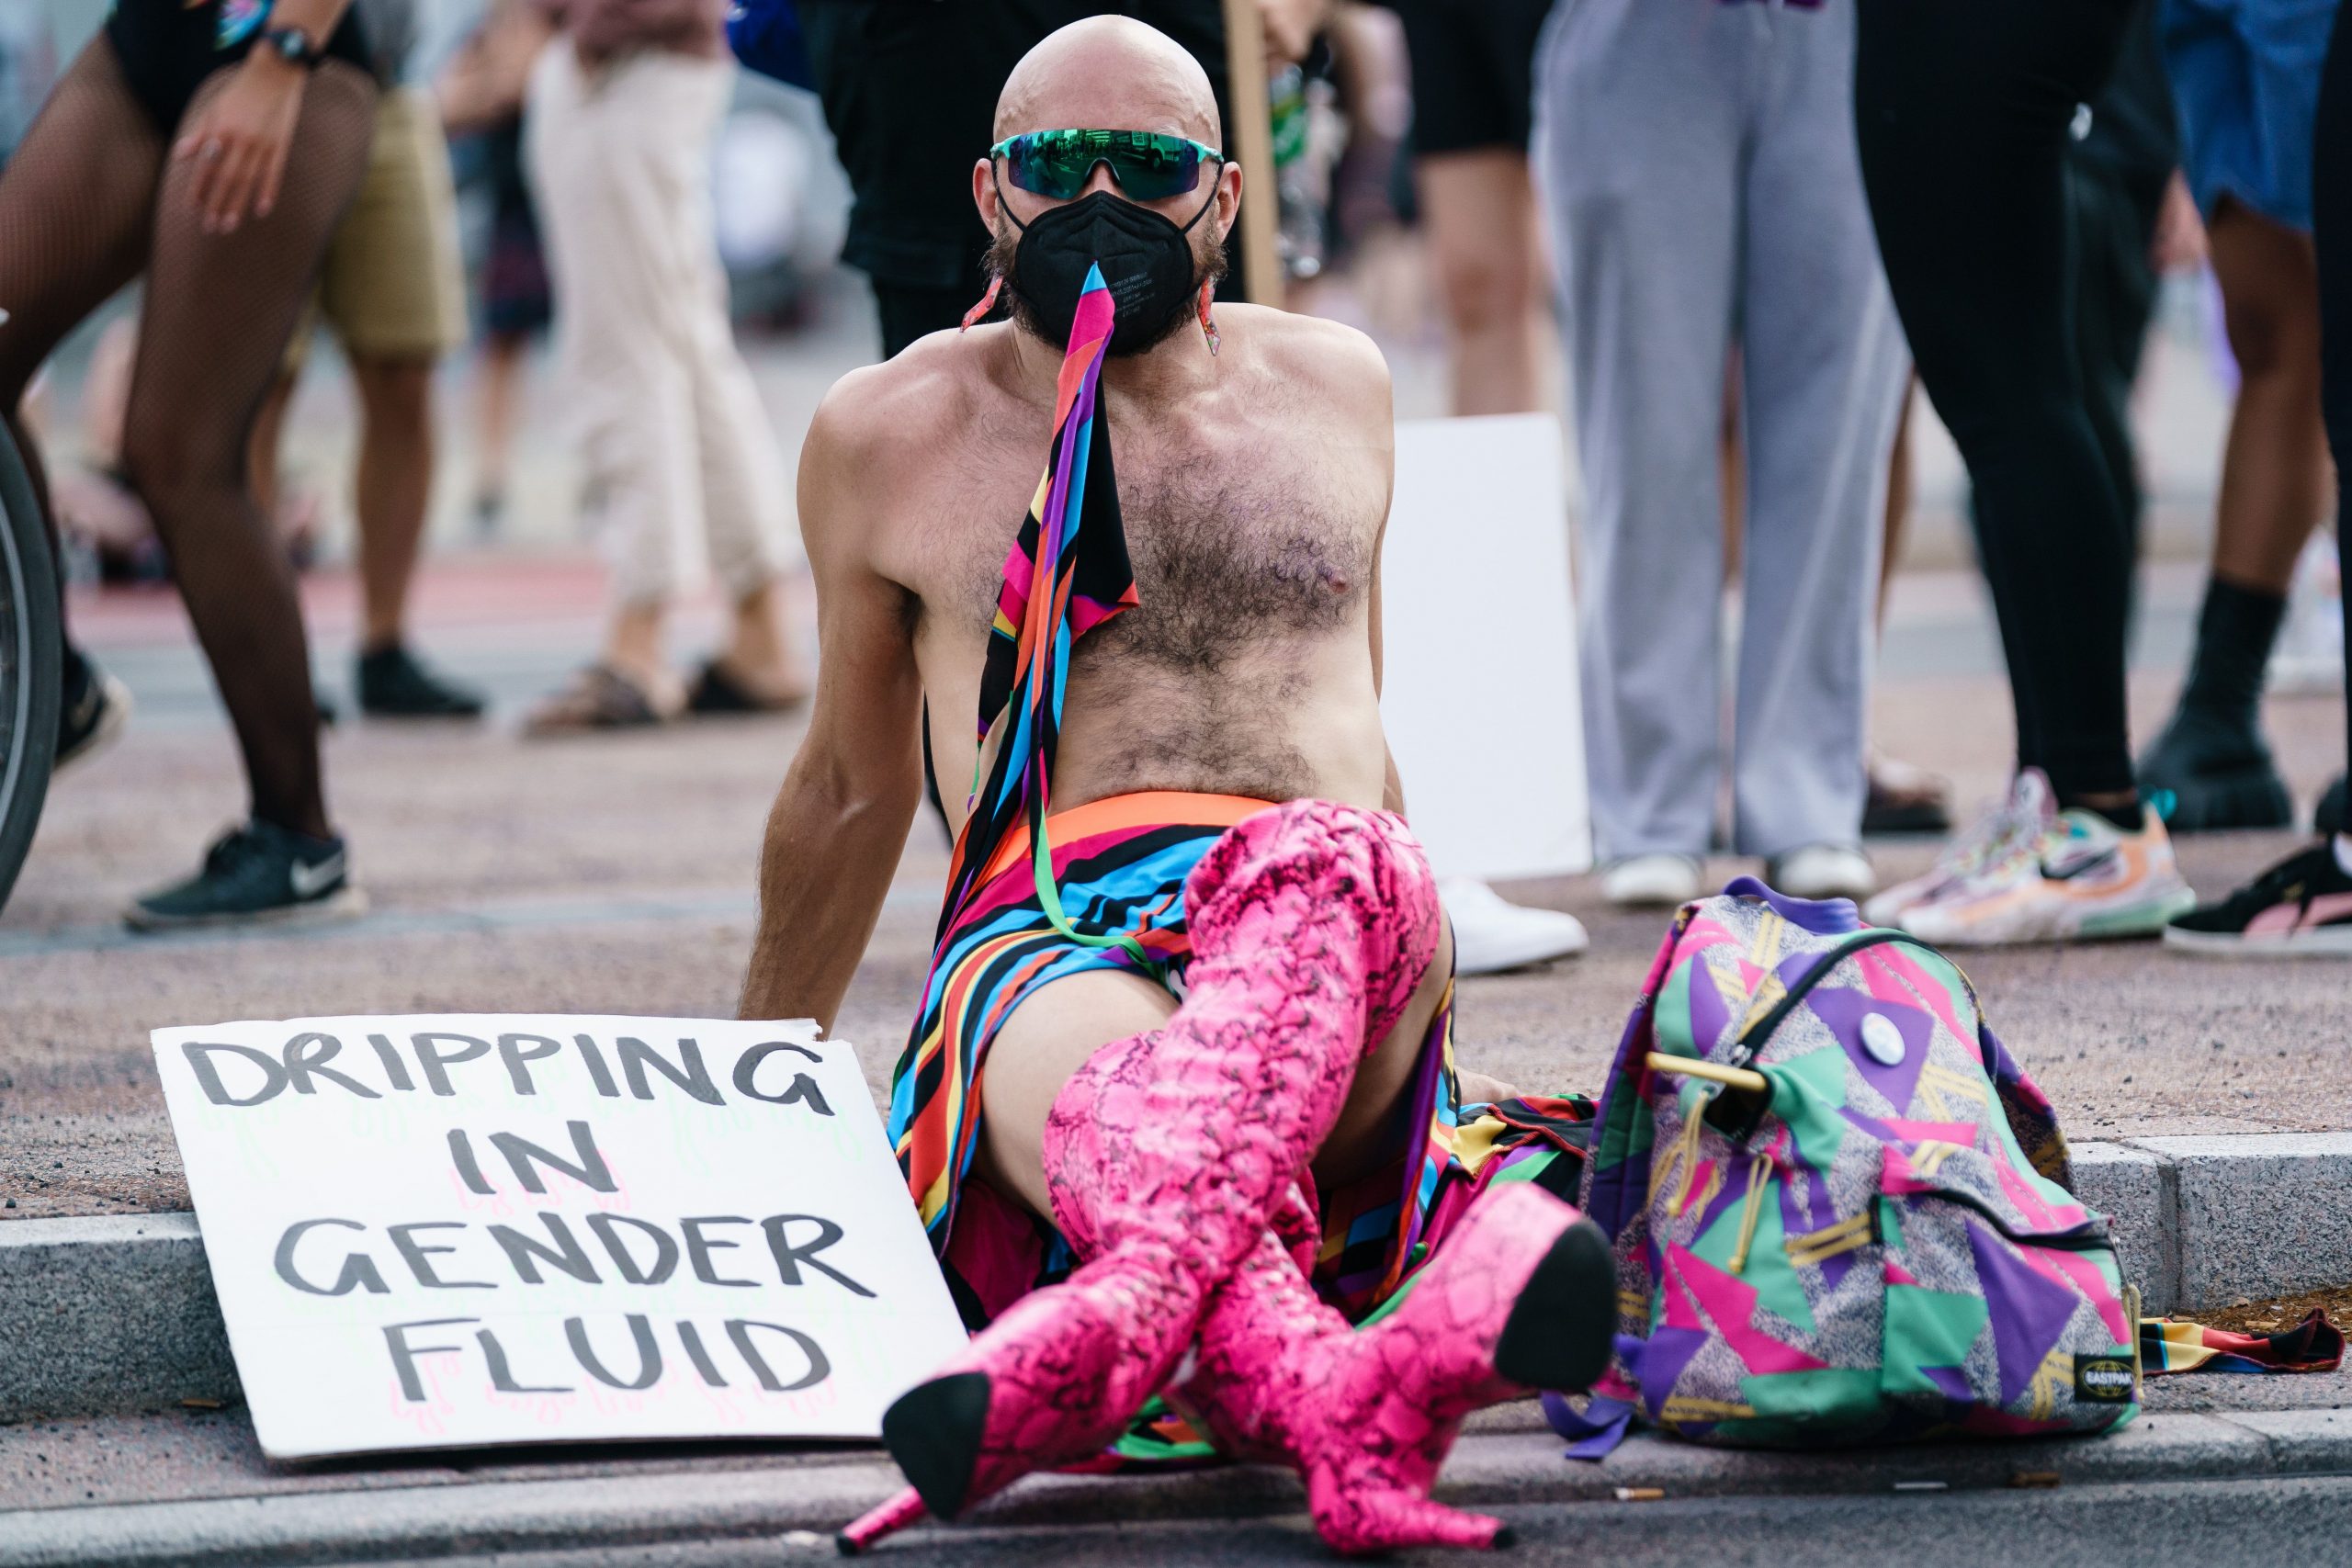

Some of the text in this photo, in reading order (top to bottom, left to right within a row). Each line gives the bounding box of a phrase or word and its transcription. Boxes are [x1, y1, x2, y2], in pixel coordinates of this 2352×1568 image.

[181, 1032, 835, 1117] DRIPPING
[447, 1120, 619, 1195] IN
[274, 1212, 877, 1299] GENDER
[383, 1314, 831, 1402] FLUID
[2085, 1371, 2132, 1385] EASTPAK
